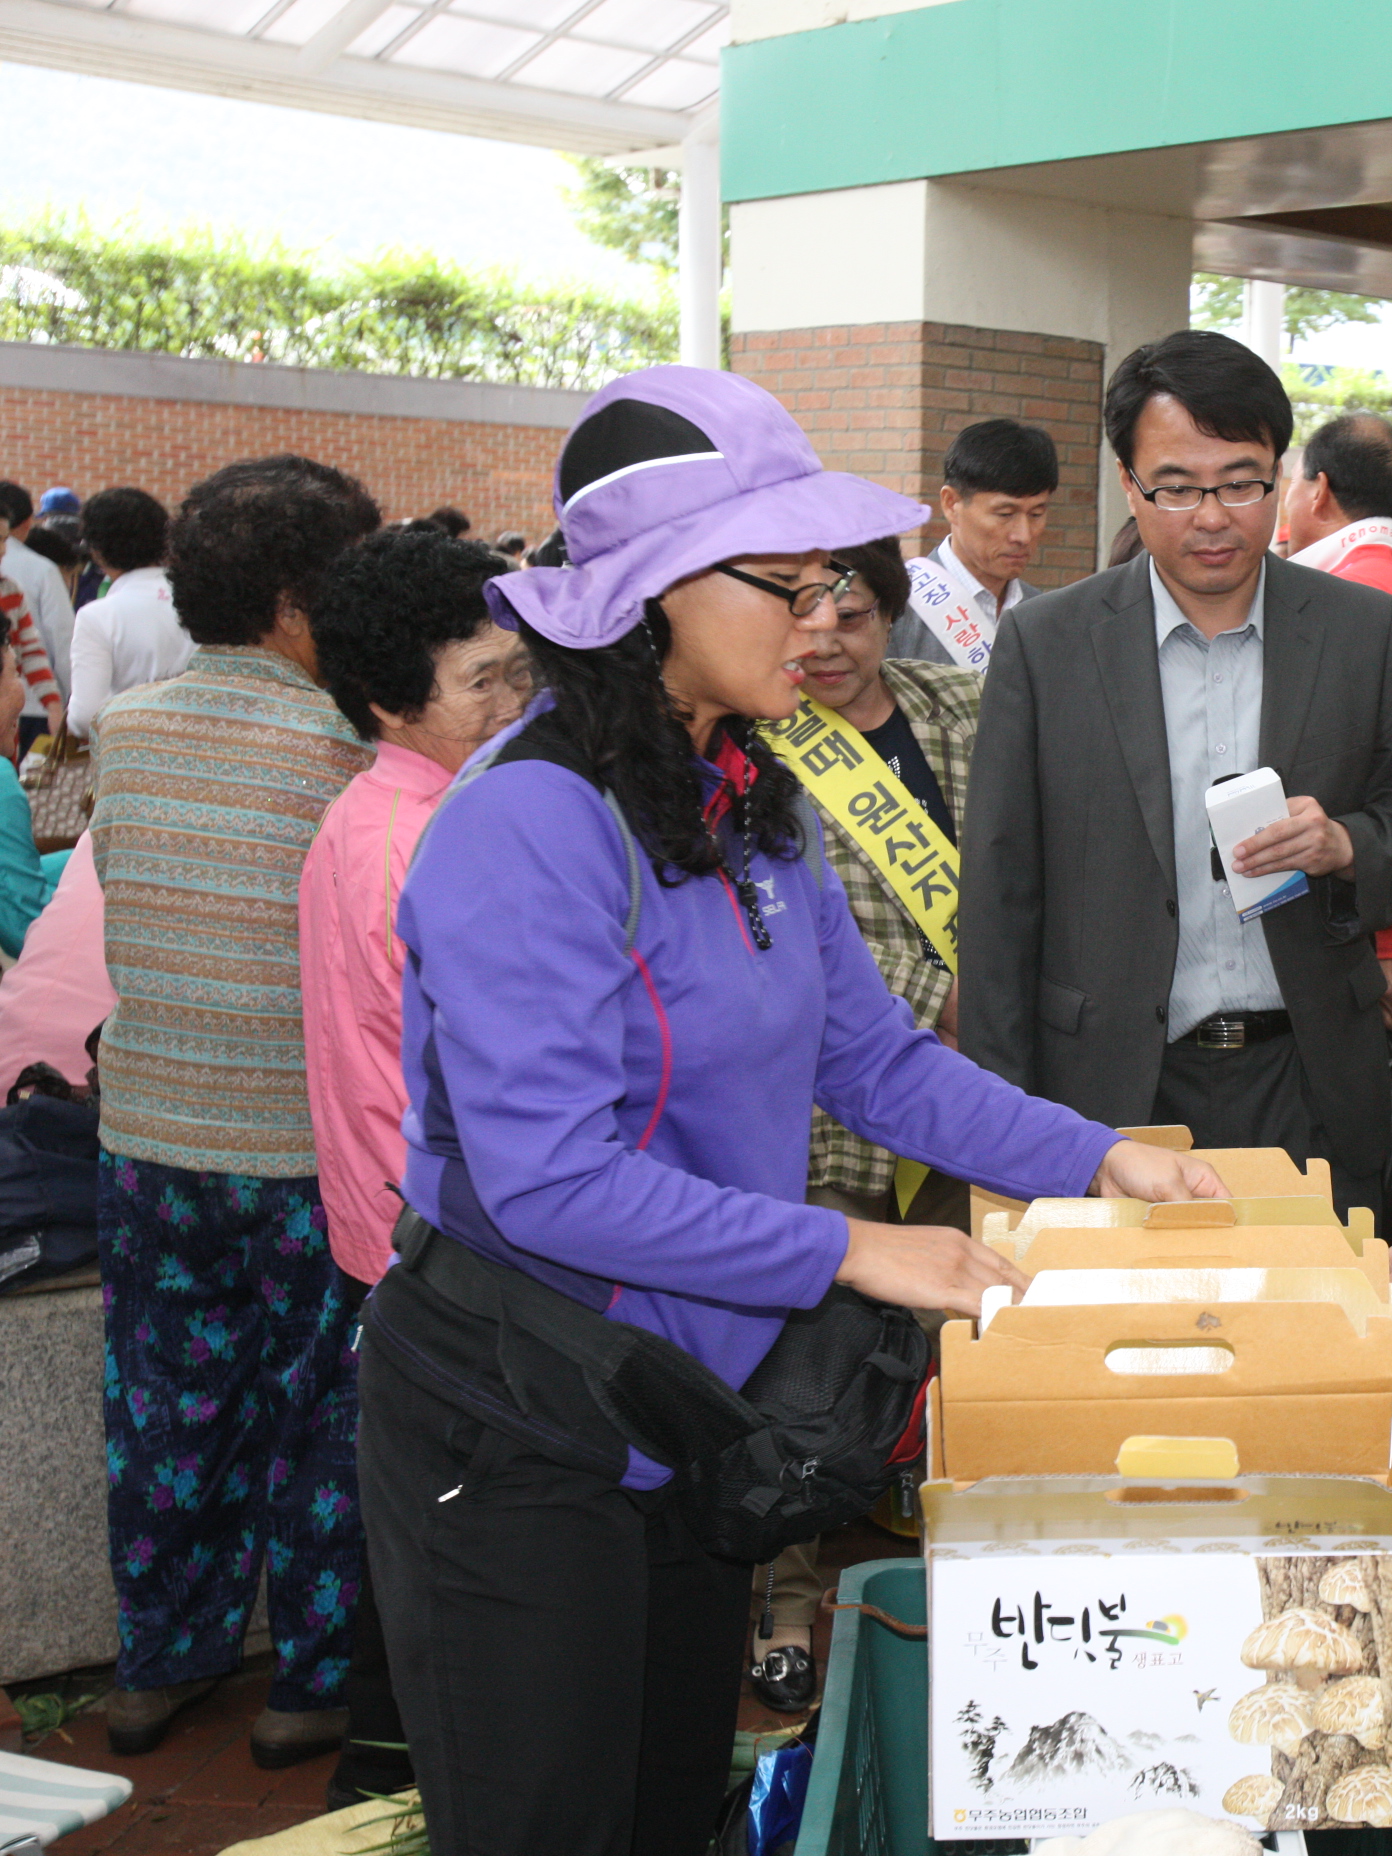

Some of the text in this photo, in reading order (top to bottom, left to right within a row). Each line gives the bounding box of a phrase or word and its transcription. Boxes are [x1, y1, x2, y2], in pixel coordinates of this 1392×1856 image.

[945, 605, 993, 675] 사랑하
[991, 1590, 1150, 1671] 반딧불
[1285, 1805, 1319, 1821] 2kg
